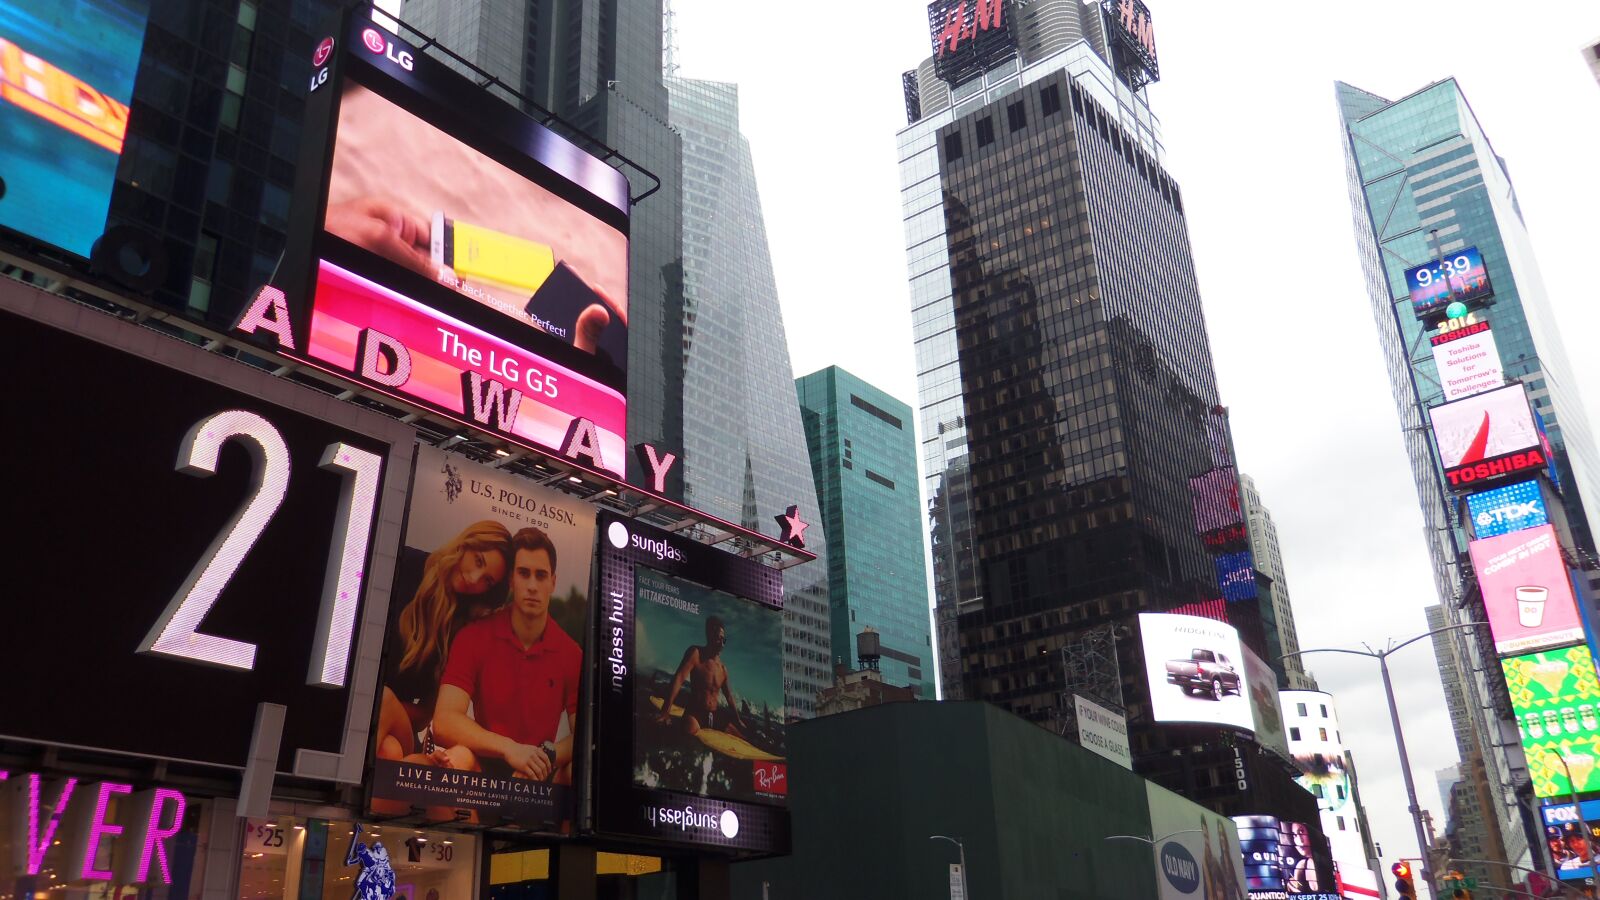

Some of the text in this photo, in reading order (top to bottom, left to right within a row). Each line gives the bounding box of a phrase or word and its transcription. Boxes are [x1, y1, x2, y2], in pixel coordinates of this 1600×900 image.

[938, 0, 1005, 57] H&M
[386, 41, 414, 71] LG
[310, 66, 329, 92] LG
[1415, 255, 1471, 287] 9:39
[438, 269, 566, 337] Just back together. Perfect!
[1431, 322, 1489, 345] TOSHIBA
[437, 327, 559, 399] The LG G5
[1446, 350, 1487, 367] Solutions
[1448, 342, 1481, 357] Toshiba
[1447, 368, 1498, 387] Tomorrow's
[1462, 363, 1476, 373] for
[1446, 450, 1544, 486] TOSHIBA
[470, 480, 577, 527] U.S. POLO ASSN.
[491, 505, 549, 529] SINCE 1890
[1489, 499, 1541, 523] TDK
[134, 409, 383, 688] 21
[631, 533, 688, 564] sunglass
[1530, 539, 1550, 555] HOT
[639, 575, 680, 594] FACE YOUR FEARS
[607, 589, 628, 694] nglass hut
[1083, 706, 1098, 723] YOUR
[1098, 713, 1111, 729] WINE
[1111, 719, 1127, 736] COULD
[1081, 728, 1104, 748] CHOOSE
[1104, 740, 1109, 750] A
[399, 766, 553, 797] LIVE AUTHENTICALLY
[1233, 747, 1247, 791] 1500
[395, 780, 422, 790] PAMELA
[423, 783, 458, 795] FLANAGAN
[465, 789, 487, 799] JONNY
[513, 795, 530, 804] POLO
[0, 771, 187, 884] VER
[659, 805, 718, 832] sunglass
[1545, 805, 1580, 823] FOX
[257, 826, 284, 848] $25
[431, 842, 453, 862] $30
[1165, 854, 1196, 881] OLD NAVY
